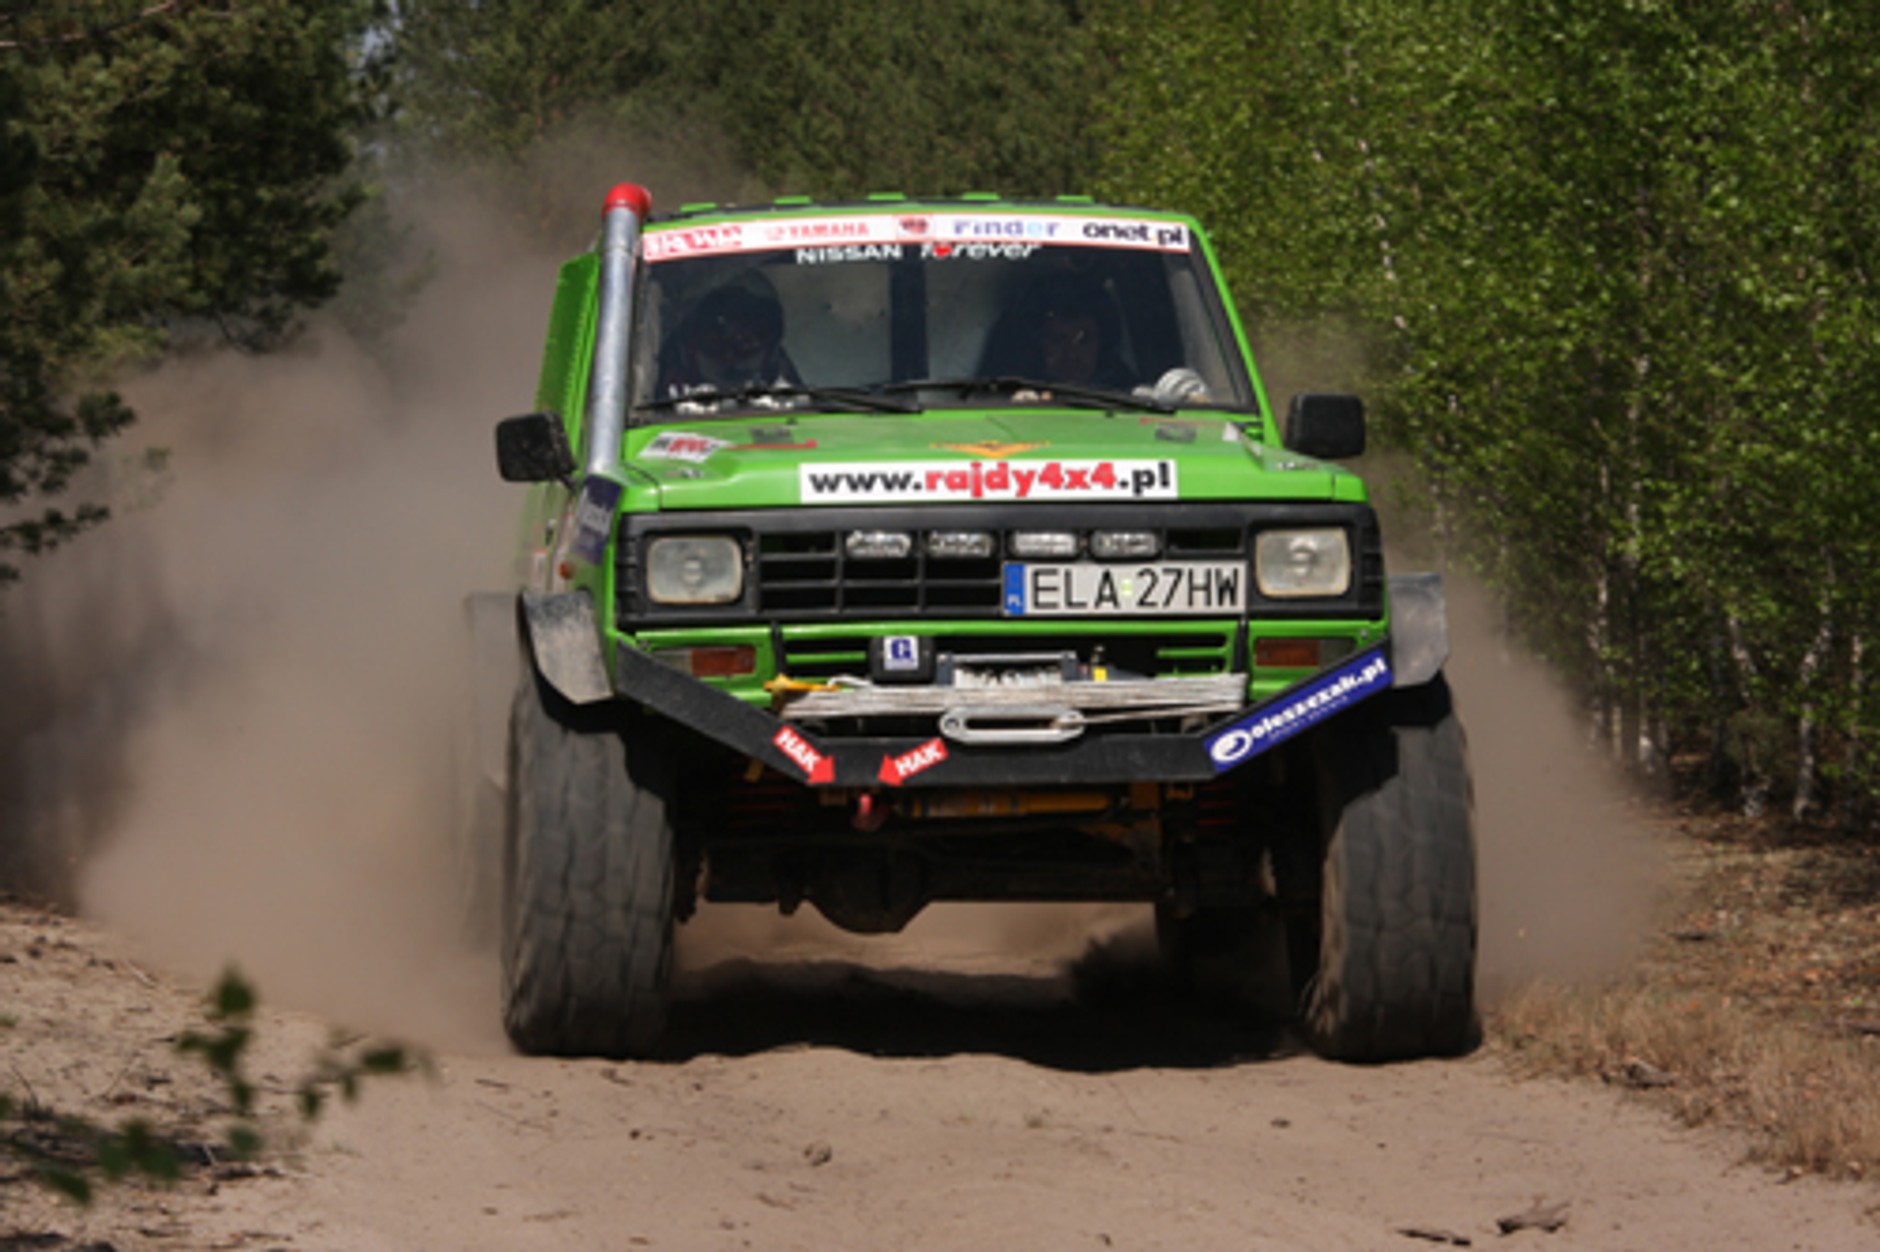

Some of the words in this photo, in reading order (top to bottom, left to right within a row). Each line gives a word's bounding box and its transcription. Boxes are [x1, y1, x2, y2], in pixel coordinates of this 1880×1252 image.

[1082, 220, 1184, 246] onet.pl
[796, 243, 902, 265] NISSAN
[808, 460, 1172, 498] www.rajdy4x4.pl
[1031, 567, 1121, 610] ELA
[1135, 566, 1240, 608] 27HW
[775, 728, 821, 773] HAK
[894, 743, 943, 777] HAK
